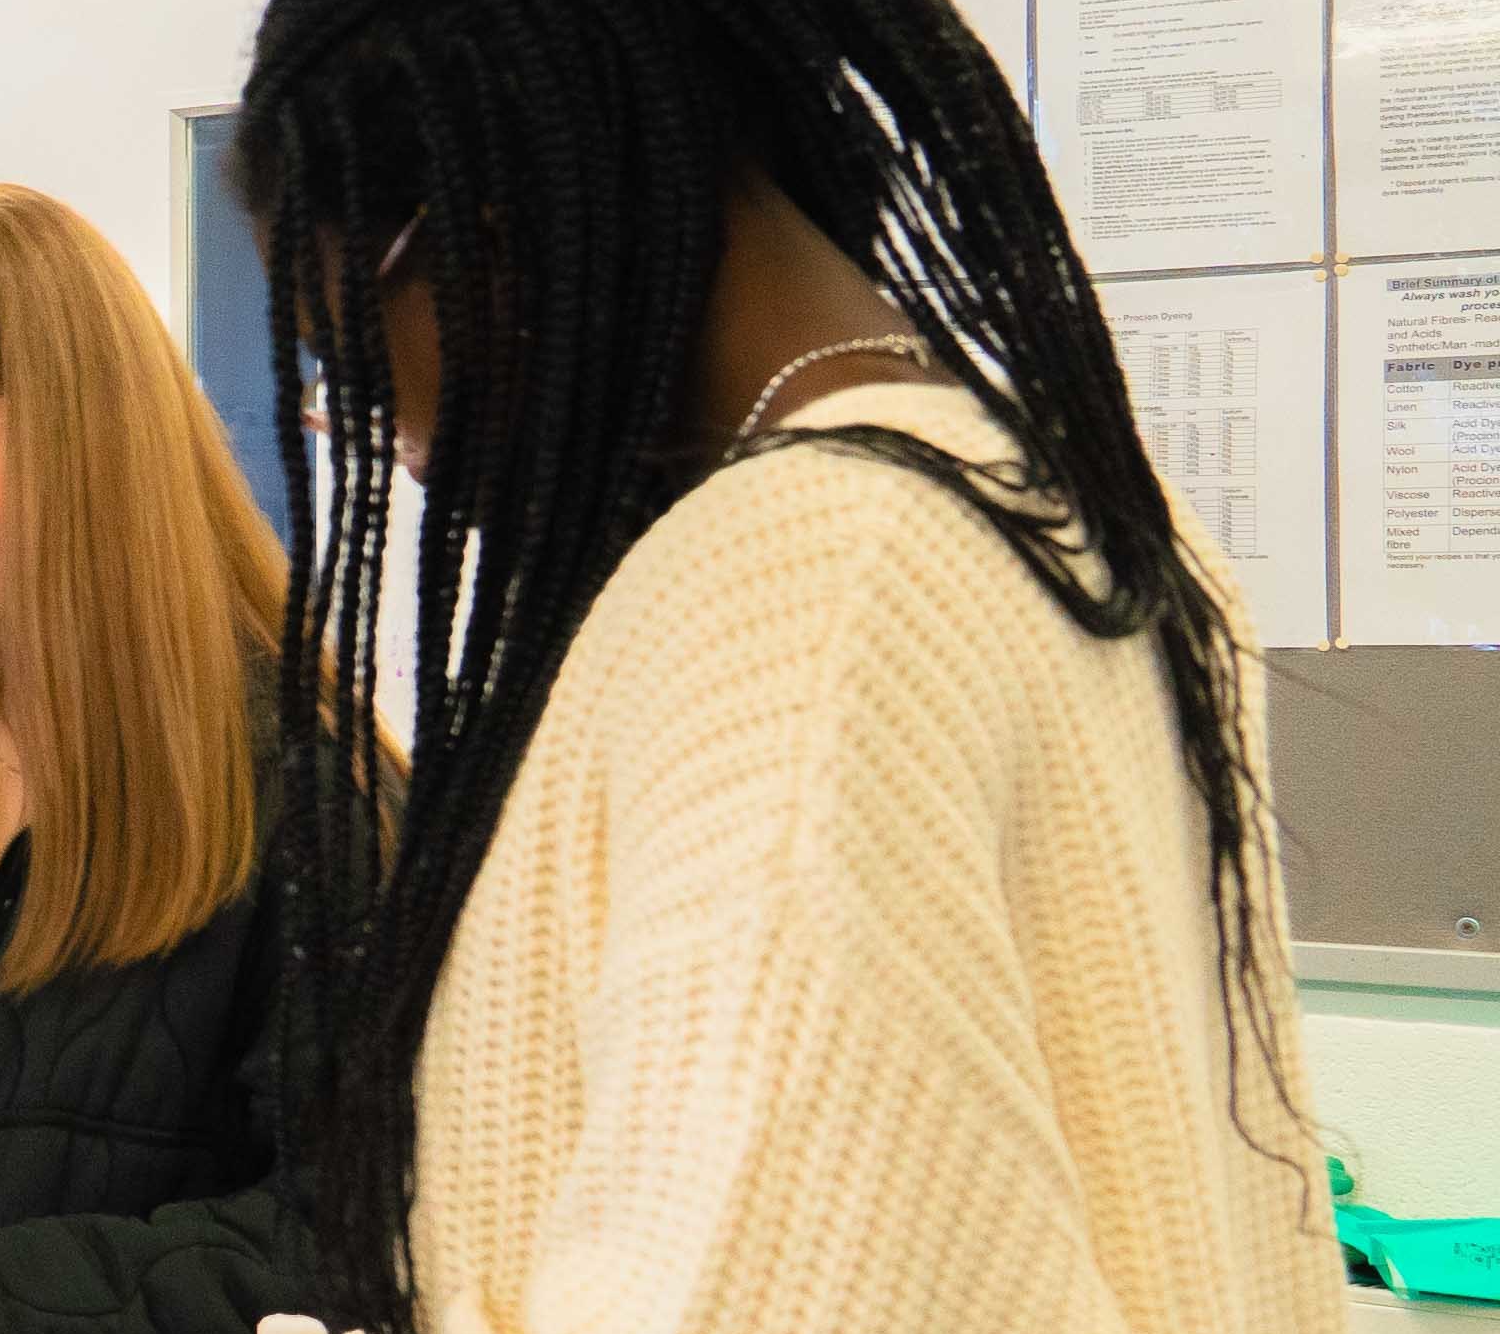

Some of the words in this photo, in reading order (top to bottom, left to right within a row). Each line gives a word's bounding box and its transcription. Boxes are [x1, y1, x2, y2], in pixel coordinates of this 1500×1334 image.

[1392, 279, 1420, 289] Brief
[1424, 277, 1482, 288] Summary
[1486, 276, 1498, 284] of
[1402, 292, 1445, 301] Always
[1449, 290, 1481, 298] wash
[1123, 314, 1159, 322] Procion
[1160, 312, 1193, 322] Dyeing
[1387, 316, 1427, 327] Natural
[1431, 314, 1471, 324] Fibres-
[1387, 330, 1408, 340] and
[1411, 329, 1442, 339] Acids
[1387, 340, 1468, 354] Synthetic/Man
[1386, 361, 1436, 372] Fabric
[1452, 360, 1482, 371] Dye
[1386, 383, 1424, 394] Cotton
[1386, 402, 1418, 412] Linen
[1386, 421, 1407, 431] Silk
[1452, 419, 1478, 428] Acid
[1386, 446, 1415, 456] Wool
[1452, 445, 1477, 454] Acid
[1386, 465, 1419, 475] Nylon
[1452, 463, 1477, 473] Acid
[1452, 476, 1500, 487] (Procion
[1386, 490, 1430, 500] Viscose
[1386, 509, 1439, 520] Polyester
[1386, 527, 1420, 537] Mixed
[1386, 539, 1411, 549] fibre
